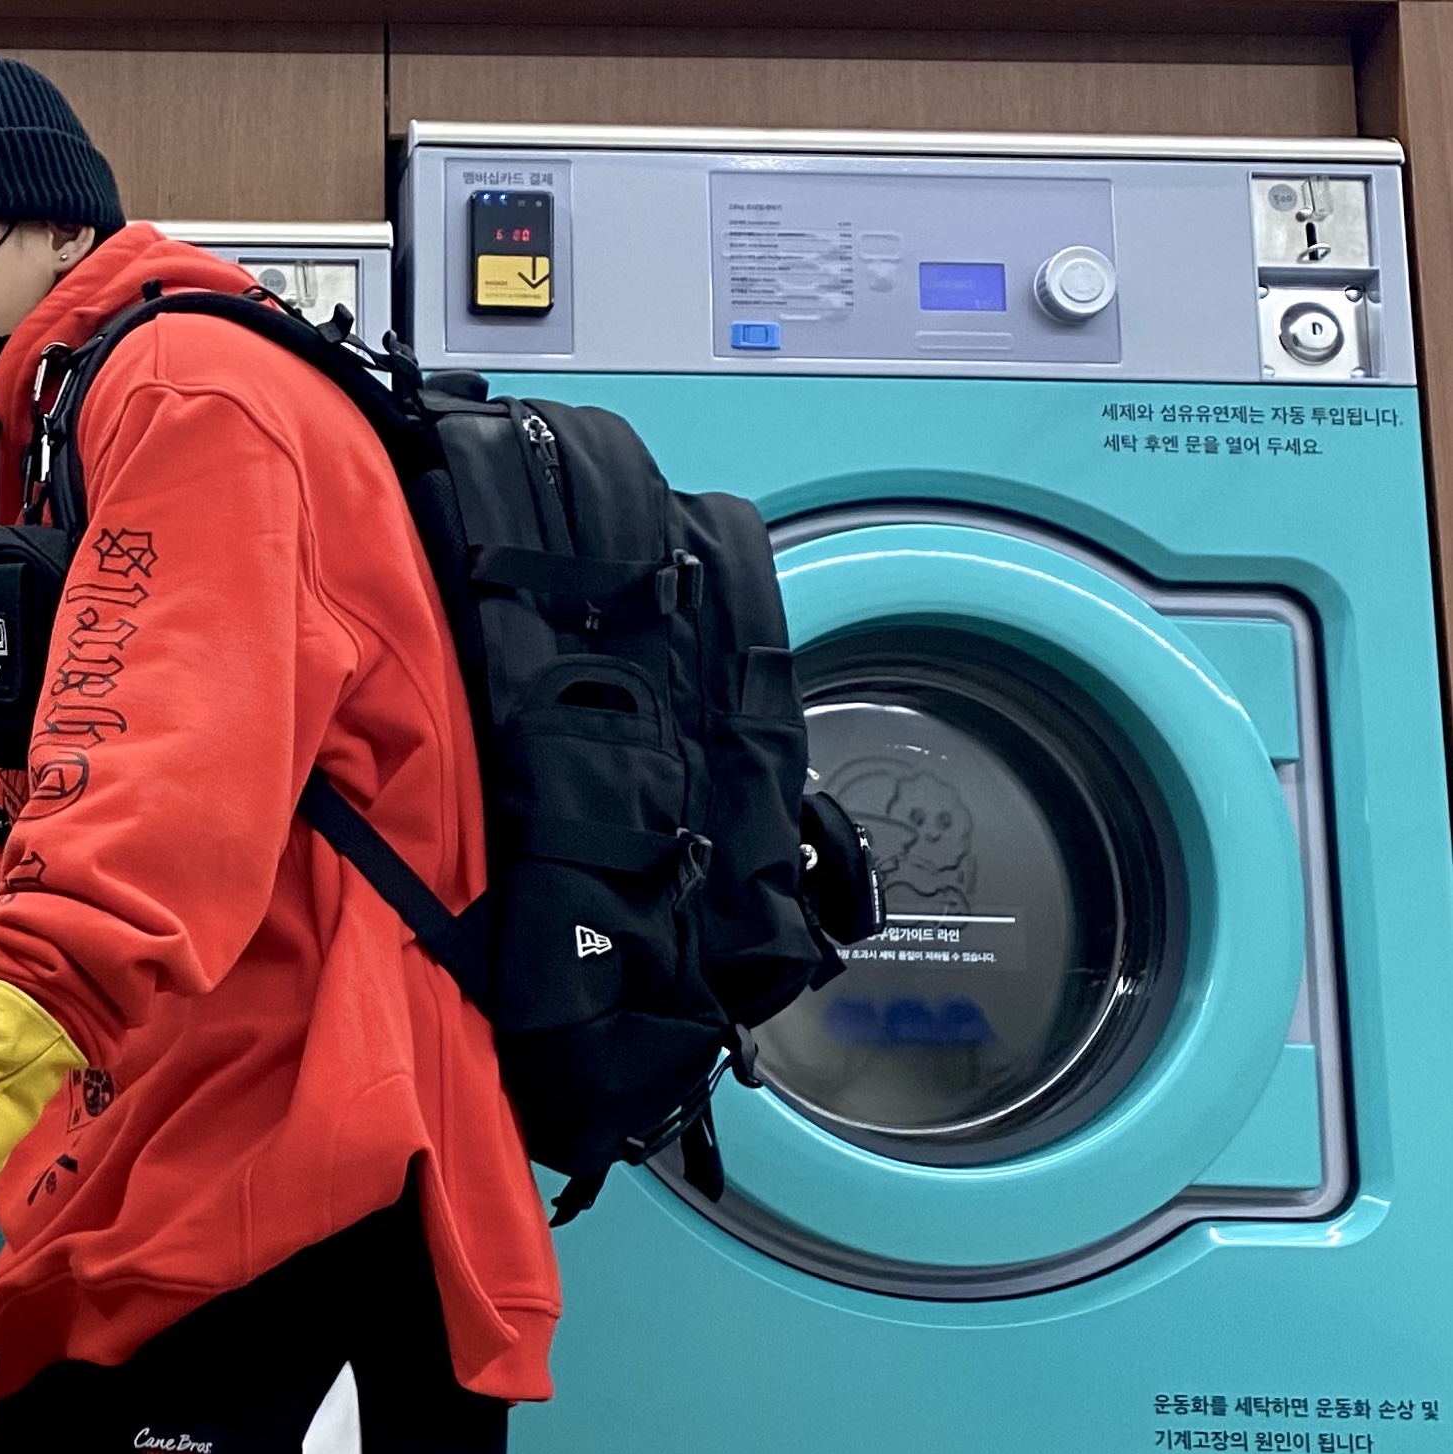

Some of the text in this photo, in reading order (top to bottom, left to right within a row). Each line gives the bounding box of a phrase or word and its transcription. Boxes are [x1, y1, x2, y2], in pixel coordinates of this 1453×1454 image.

[462, 170, 554, 187] 멤버십카드 결제
[1101, 403, 1404, 428] 세제와 섬유유연제는 자동 투입됩니다.
[1103, 434, 1138, 454] 세탁
[1144, 434, 1181, 454] 후엔
[1185, 435, 1221, 455] 문을
[1225, 435, 1260, 456] 열어
[937, 929, 960, 942] 라인
[1154, 1394, 1440, 1421] 운동화를 세탁하면 운동화 손상 및
[1154, 1430, 1374, 1454] 기계고장의 원인이 됩니다
